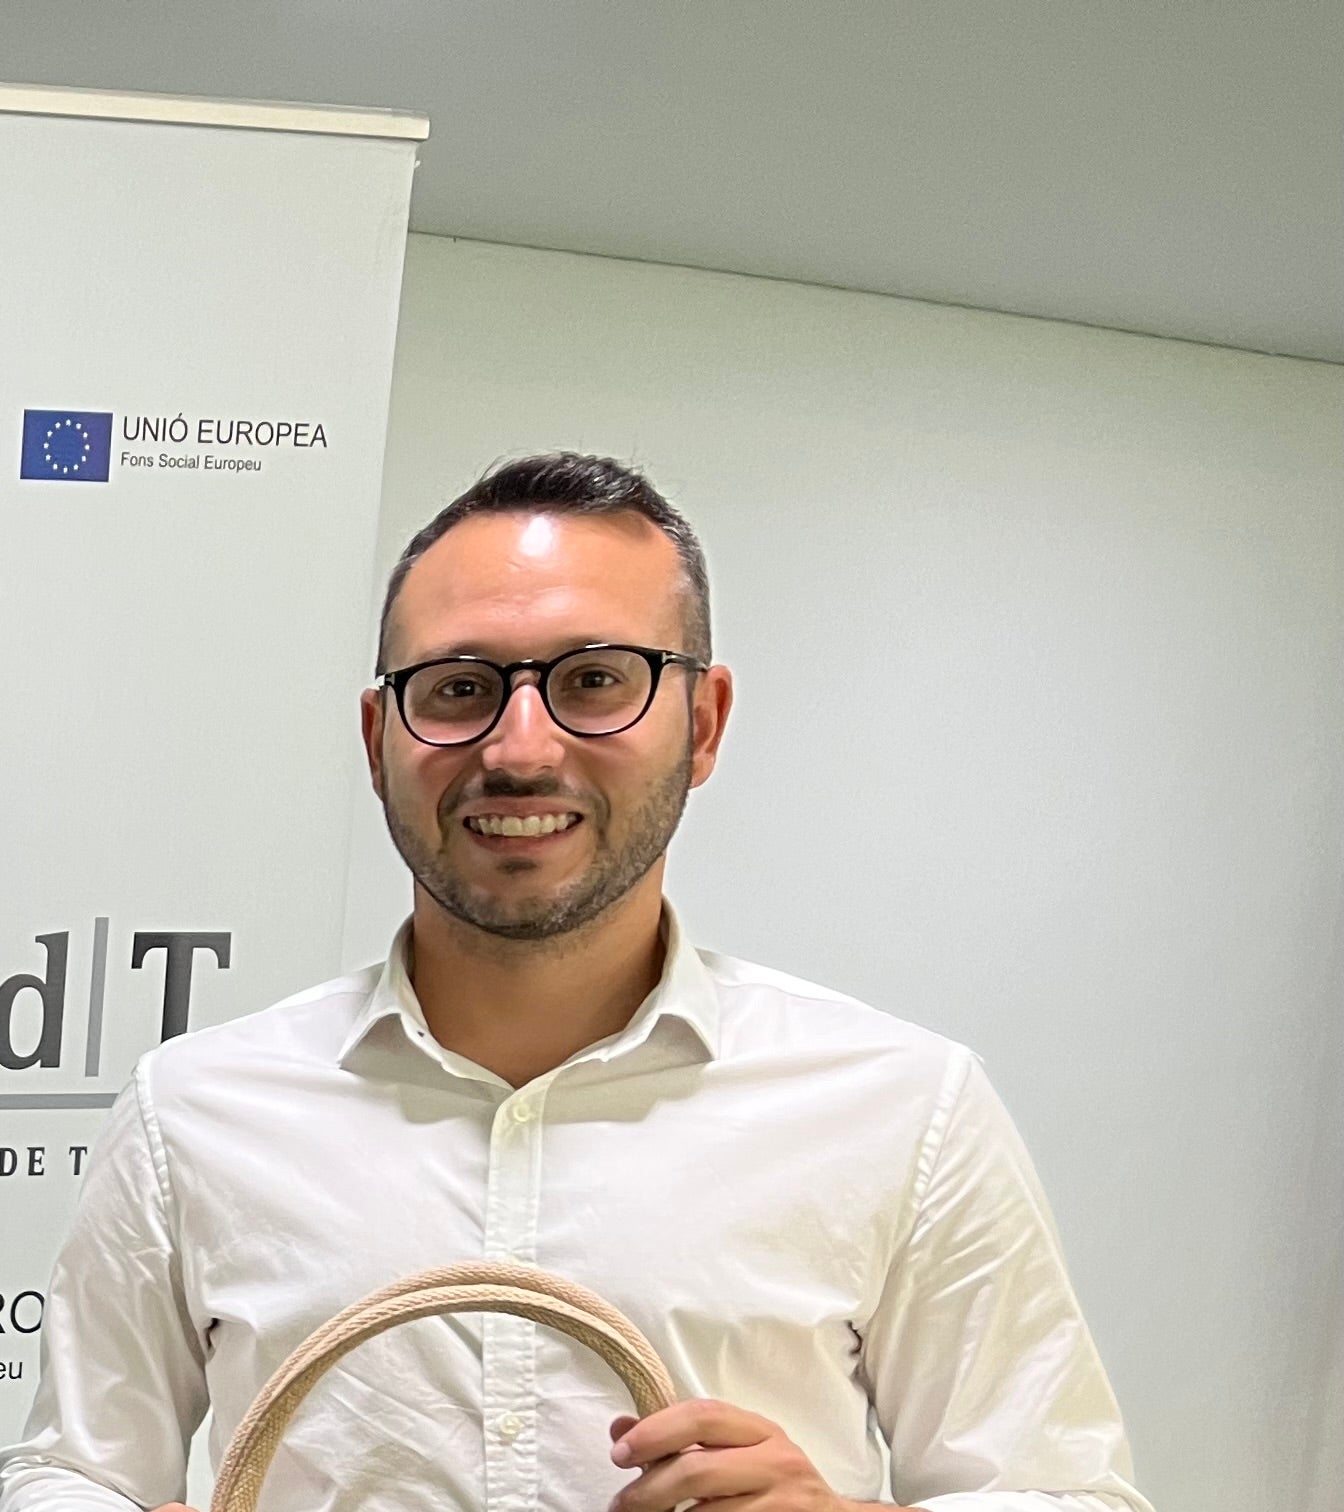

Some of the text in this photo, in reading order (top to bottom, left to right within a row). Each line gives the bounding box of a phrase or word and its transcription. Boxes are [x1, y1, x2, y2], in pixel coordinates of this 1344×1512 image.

[123, 413, 328, 448] UNIÓ EUROPEA
[120, 452, 262, 473] Fons Social Europeu
